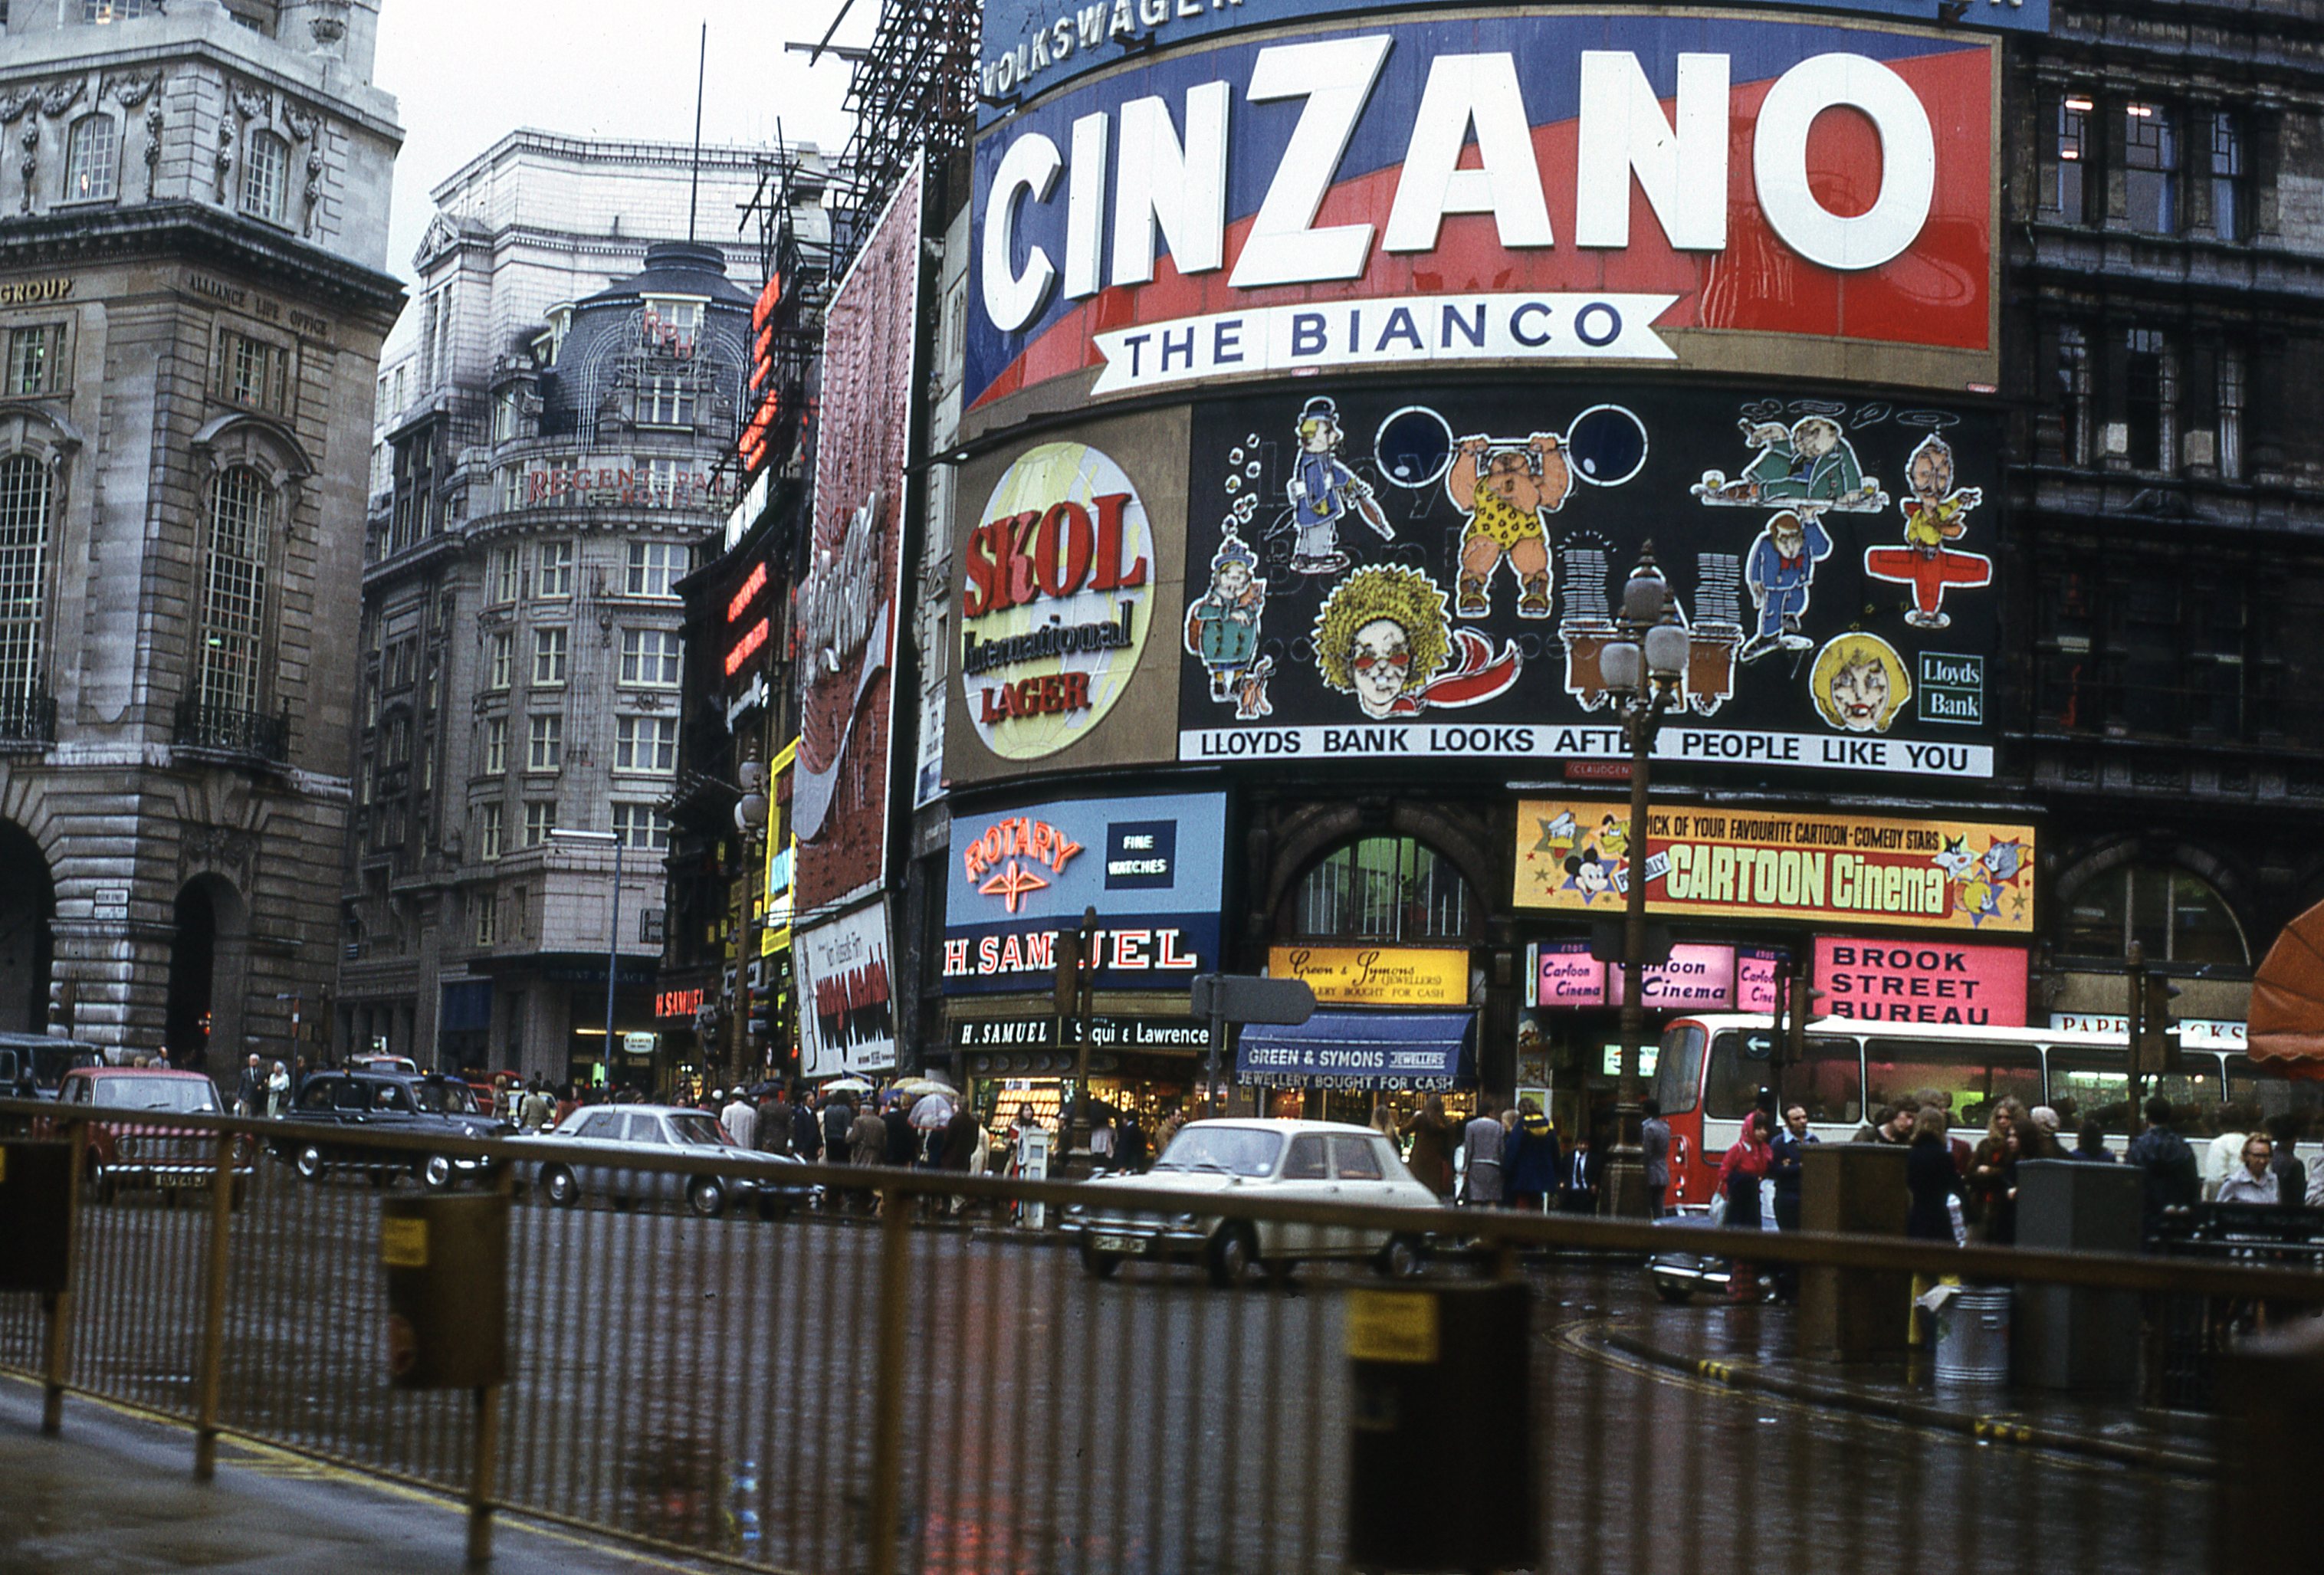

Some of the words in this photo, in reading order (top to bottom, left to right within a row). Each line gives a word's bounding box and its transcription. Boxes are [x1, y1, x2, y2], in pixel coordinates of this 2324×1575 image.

[982, 0, 1243, 97] VOLKSWAG
[983, 34, 1935, 333] CINZANO
[1, 278, 71, 304] GROUP
[189, 273, 245, 308] ALLIANCE
[255, 297, 280, 321] LIFE
[290, 310, 327, 336] OFFICE
[644, 310, 693, 359] RPH
[1124, 320, 1244, 377] THE
[1291, 302, 1623, 356] BIANCO
[528, 468, 652, 504] REGENT
[963, 493, 1147, 619] SKOL
[963, 599, 1134, 676] International
[1924, 659, 1980, 686] Lloyds
[980, 671, 1093, 725] LAGER
[1932, 693, 1979, 717] Bank
[1201, 730, 1302, 756] LLOYDS
[1324, 729, 1409, 753] BANK
[1430, 728, 1535, 752] LOOKS
[1554, 729, 1658, 756] AFTE
[1682, 733, 1800, 760] PEOPLE
[1822, 740, 1887, 766] LIKE
[1905, 744, 1969, 771] YOU
[1123, 835, 1153, 850] FINE
[1674, 816, 1689, 837] OF
[1693, 817, 1725, 838] YOUR
[1729, 819, 1792, 842] FAVOURITE
[1906, 829, 1939, 851] STARS
[964, 817, 1085, 884] ROTARY
[1108, 859, 1167, 875] WATCHES
[1666, 843, 1826, 907] CARTOON
[1831, 852, 1945, 914] Cinema
[1289, 950, 1334, 979] Green
[1352, 950, 1415, 986] Symons
[1543, 962, 1590, 978] Cartoon
[1618, 959, 1705, 975] artoon
[1833, 947, 1967, 972] BROOK
[1642, 976, 1727, 999] Cinema
[1741, 966, 1774, 983] Cartoo
[1831, 973, 1980, 999] STREET
[1344, 988, 1385, 997] BOUGHT
[1392, 988, 1411, 997] FOR
[1417, 989, 1444, 999] CASH
[1556, 981, 1600, 996] Cinema
[1831, 1001, 1989, 1025] BUREAU
[983, 1022, 1047, 1043] SAMUEL
[1075, 1022, 1115, 1046] Squi
[1137, 1022, 1209, 1045] Lawrence
[1249, 1048, 1299, 1065] GREEN
[1304, 1050, 1314, 1065] &
[1319, 1051, 1384, 1067] SYMONS
[1390, 1052, 1446, 1066] JEWELLERS
[1238, 1071, 1309, 1088] JEWELLERY
[1315, 1076, 1374, 1089] BOUGHT
[1380, 1076, 1408, 1090] FOR
[1415, 1076, 1454, 1090] CASH
